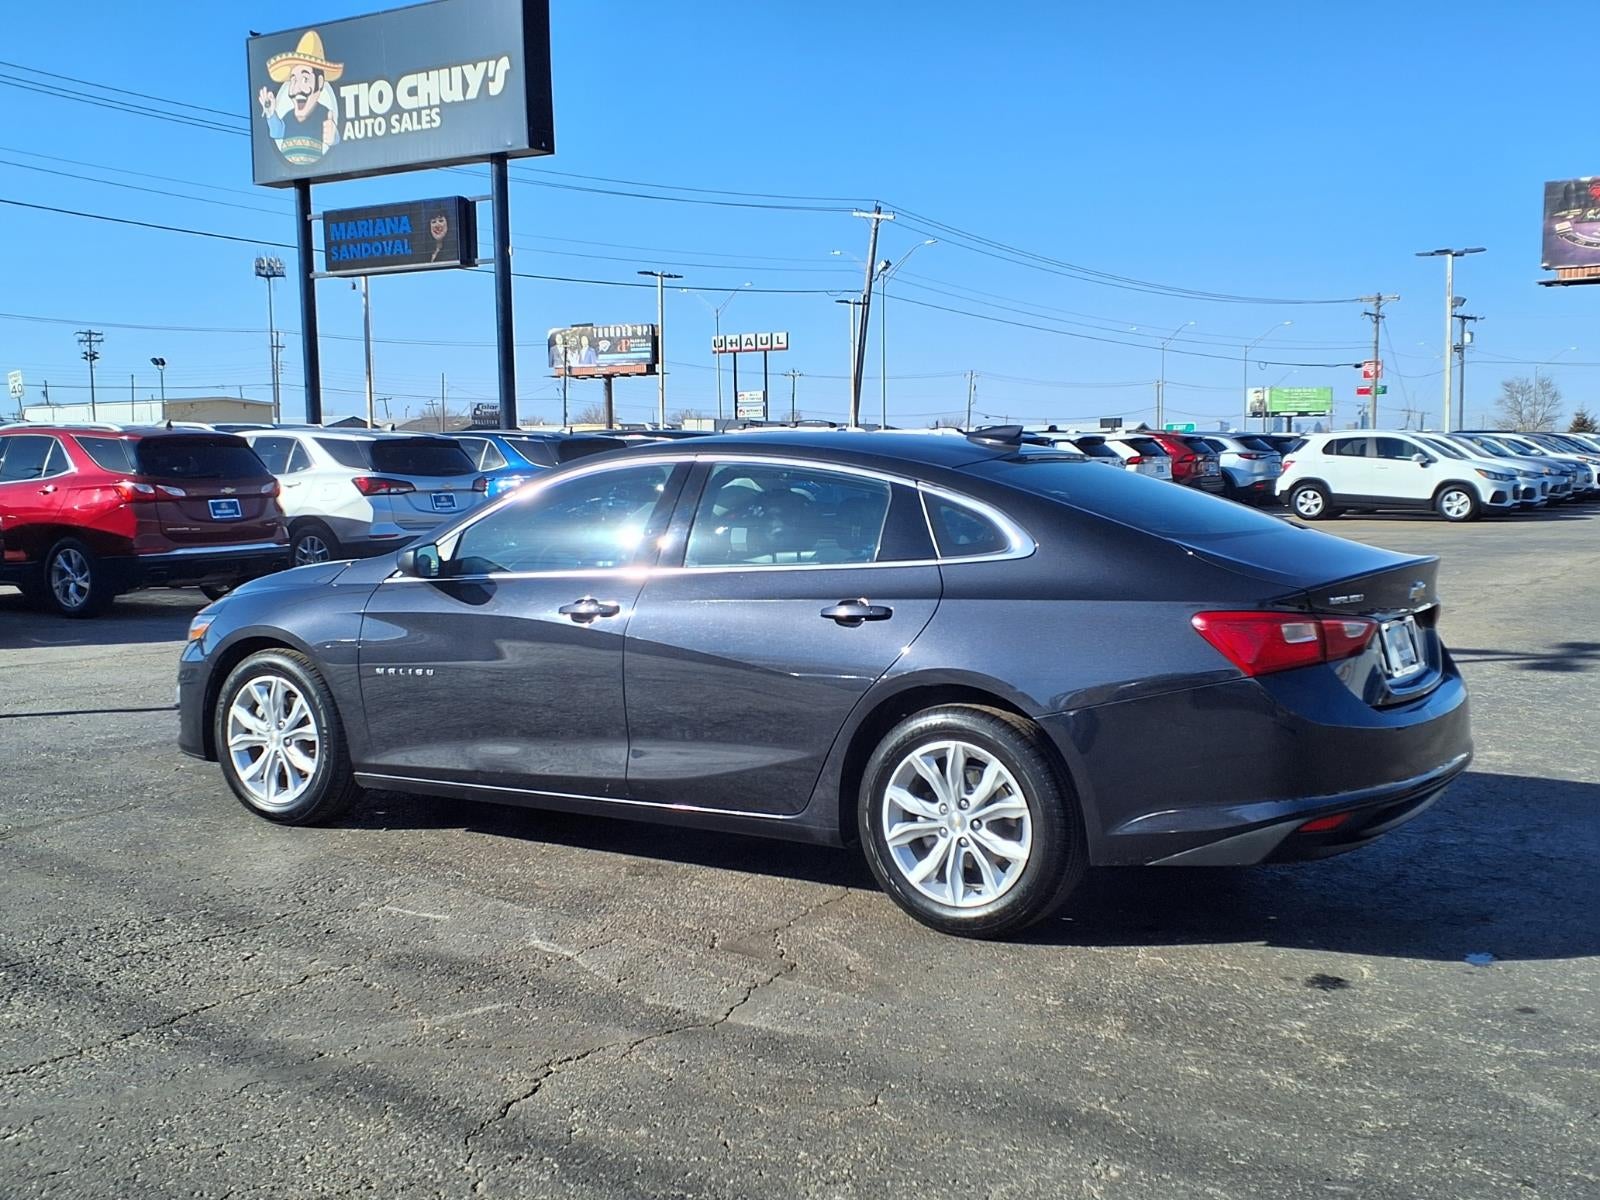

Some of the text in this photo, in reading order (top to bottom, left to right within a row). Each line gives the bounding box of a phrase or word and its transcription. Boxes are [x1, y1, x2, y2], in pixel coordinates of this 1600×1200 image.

[340, 56, 511, 119] TIO CHUY'S
[342, 108, 442, 141] AUTO SALES
[329, 215, 412, 241] MARIANA
[331, 239, 412, 261] SANDOVAL
[11, 383, 23, 393] 40
[375, 667, 434, 676] MALIBU
